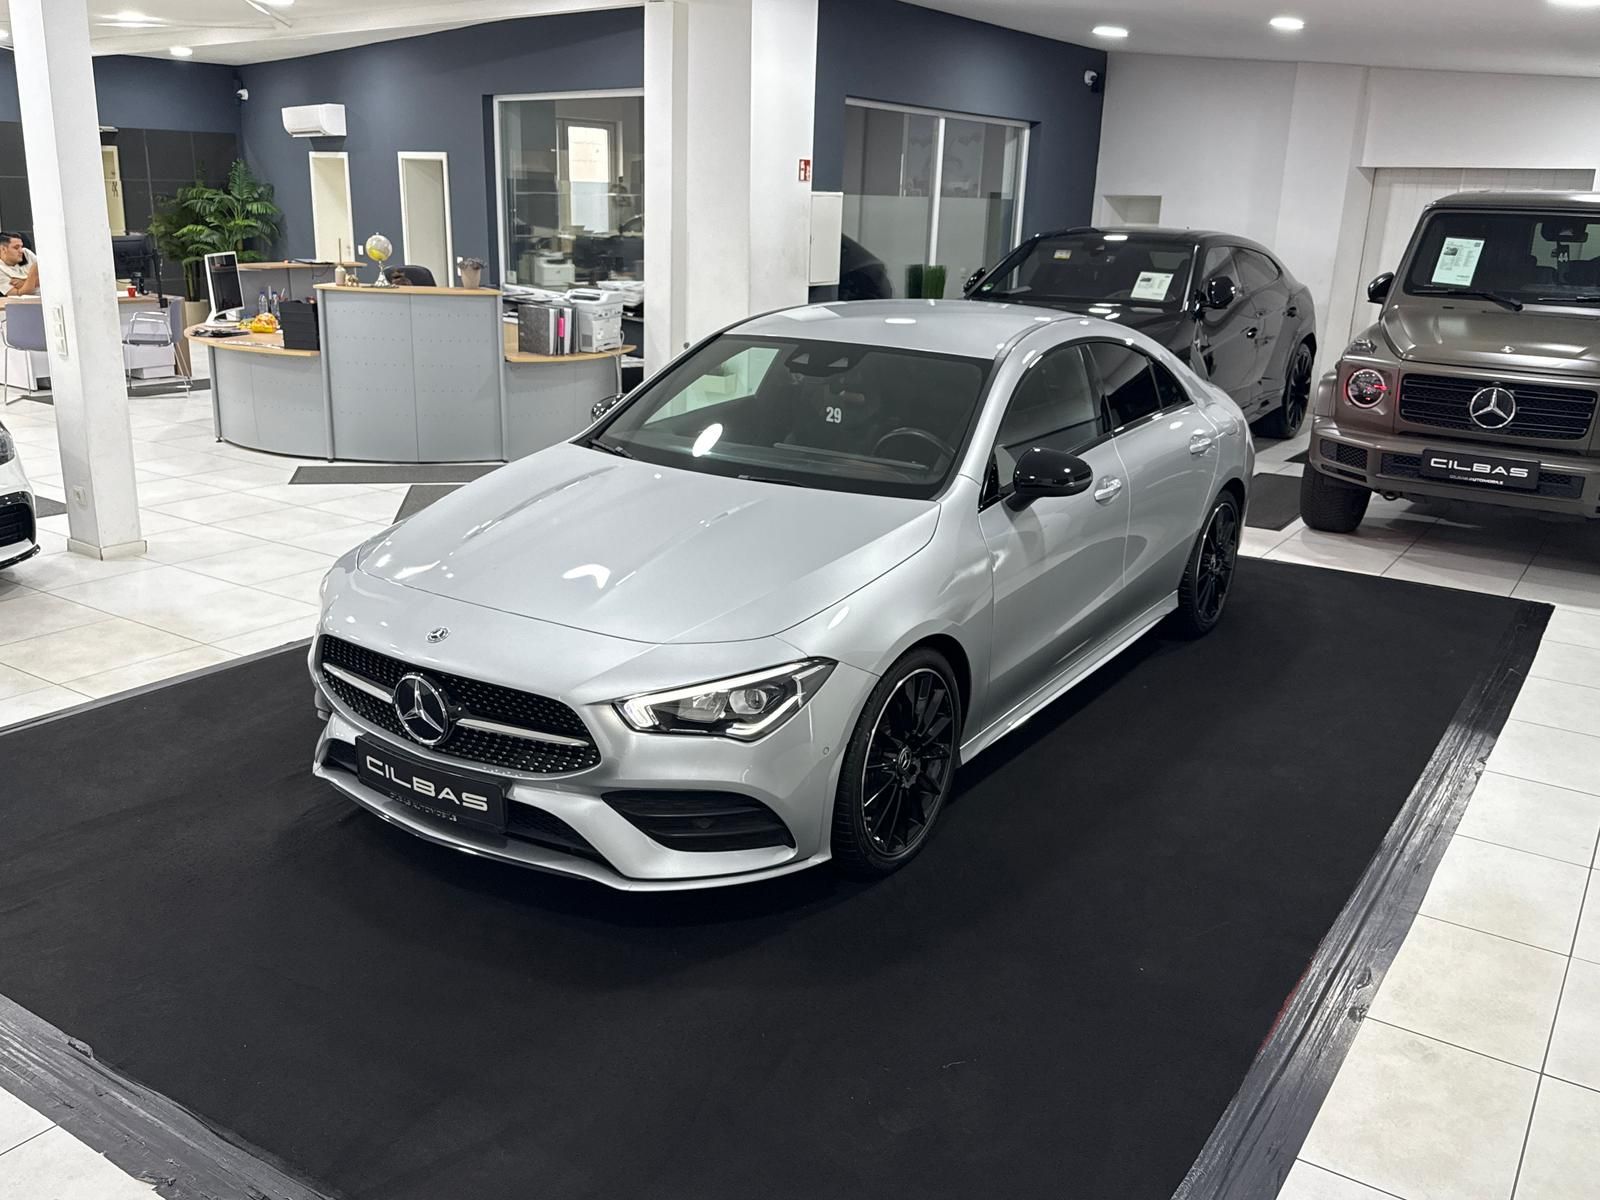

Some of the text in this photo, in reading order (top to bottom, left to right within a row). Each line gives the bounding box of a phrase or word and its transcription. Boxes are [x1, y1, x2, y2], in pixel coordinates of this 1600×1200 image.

[826, 406, 842, 424] 29
[1430, 458, 1529, 478] CILBAS
[366, 755, 488, 812] CILBAS
